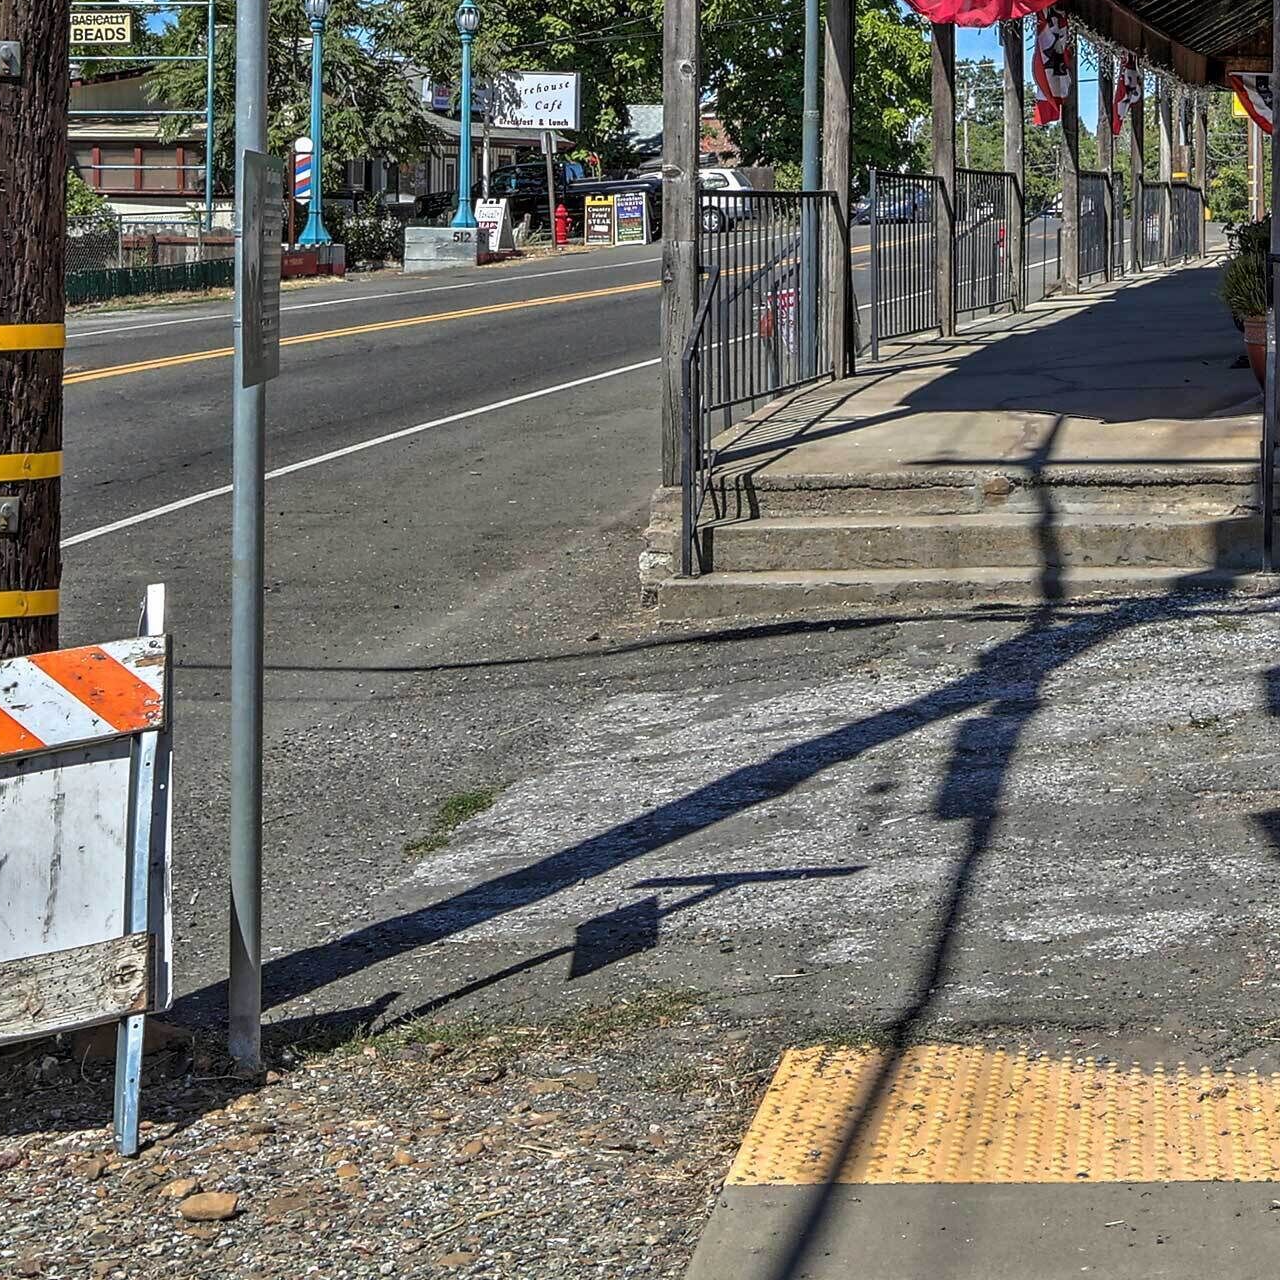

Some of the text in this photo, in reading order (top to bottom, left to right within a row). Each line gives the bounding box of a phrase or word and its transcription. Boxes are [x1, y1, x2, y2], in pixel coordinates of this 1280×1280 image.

[71, 14, 128, 26] BASICALLY
[73, 27, 126, 41] BEADS
[517, 81, 570, 95] irehouse
[535, 99, 563, 113] Café
[538, 118, 544, 126] &
[549, 118, 569, 127] Lunch
[453, 231, 471, 243] 512
